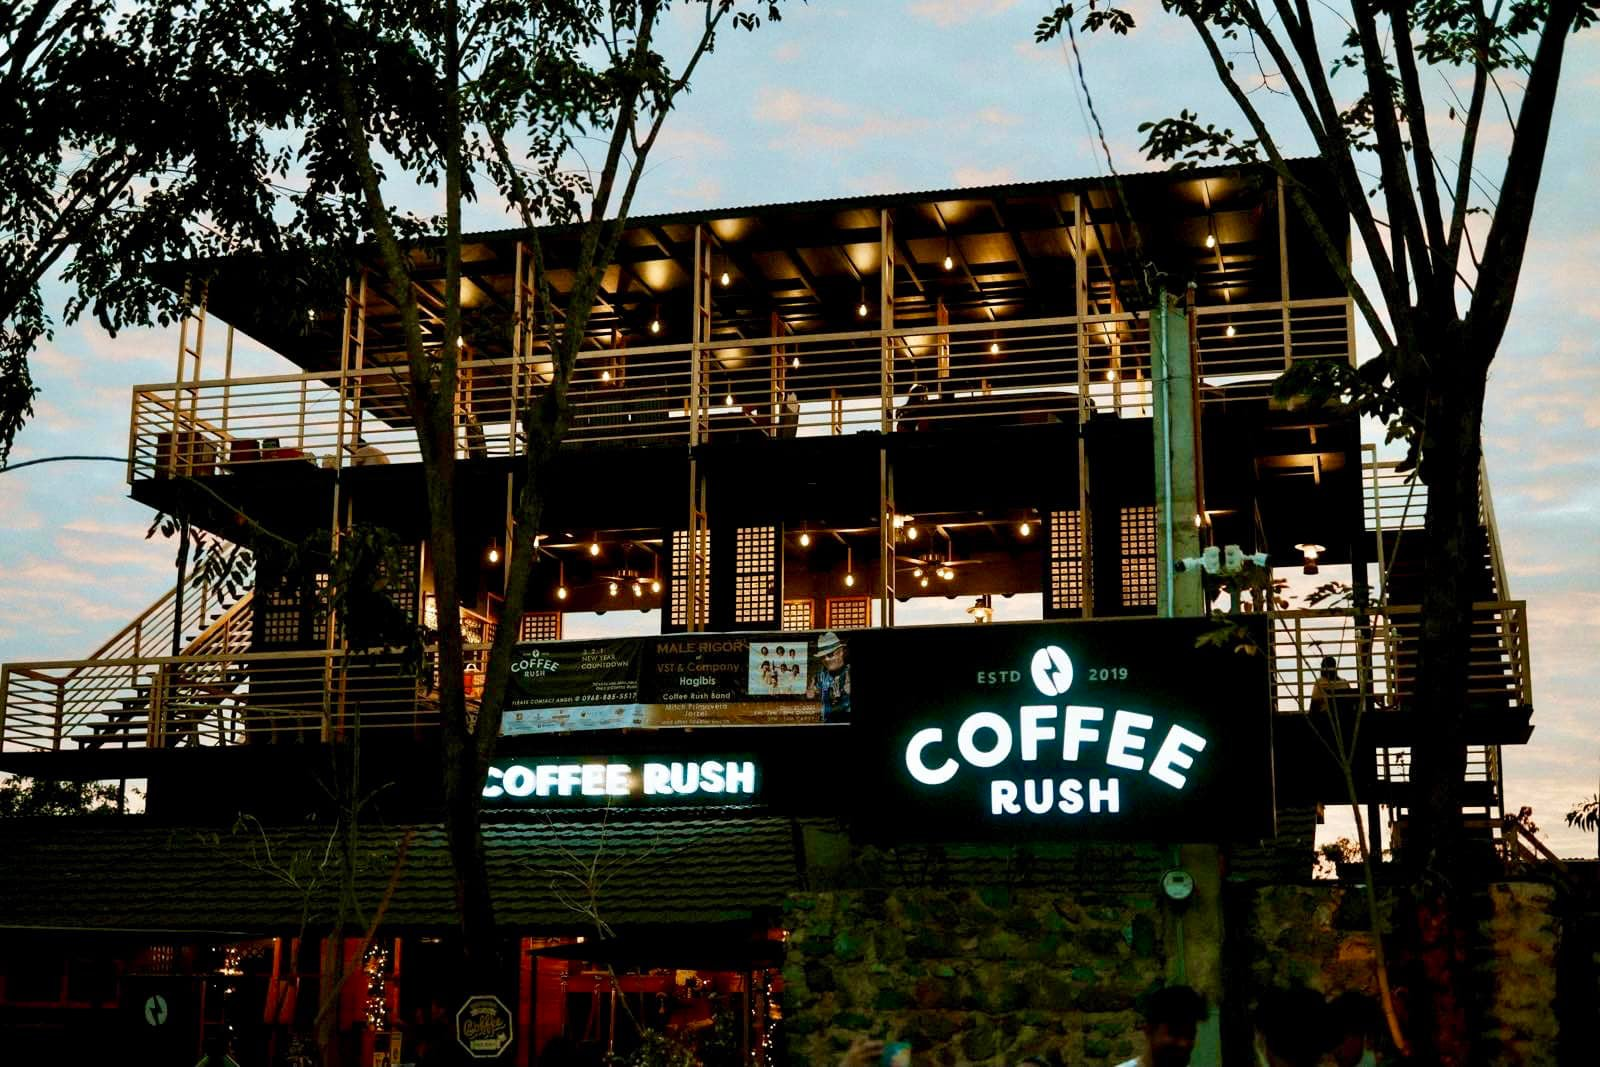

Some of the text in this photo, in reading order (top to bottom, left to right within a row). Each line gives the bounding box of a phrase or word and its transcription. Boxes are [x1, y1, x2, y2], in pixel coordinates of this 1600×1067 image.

[656, 641, 743, 655] MALE RIGOR
[511, 658, 560, 672] COFFEE
[581, 661, 629, 670] COUNTDOWN
[687, 662, 740, 673] Company
[679, 675, 717, 687] Hagibis
[976, 667, 1129, 685] ESTD 2019
[690, 692, 709, 700] Rush
[711, 692, 731, 700] Band
[905, 704, 1207, 790] COFFEE
[482, 760, 755, 798] COFFEE RUSH
[990, 777, 1120, 815] RUSH
